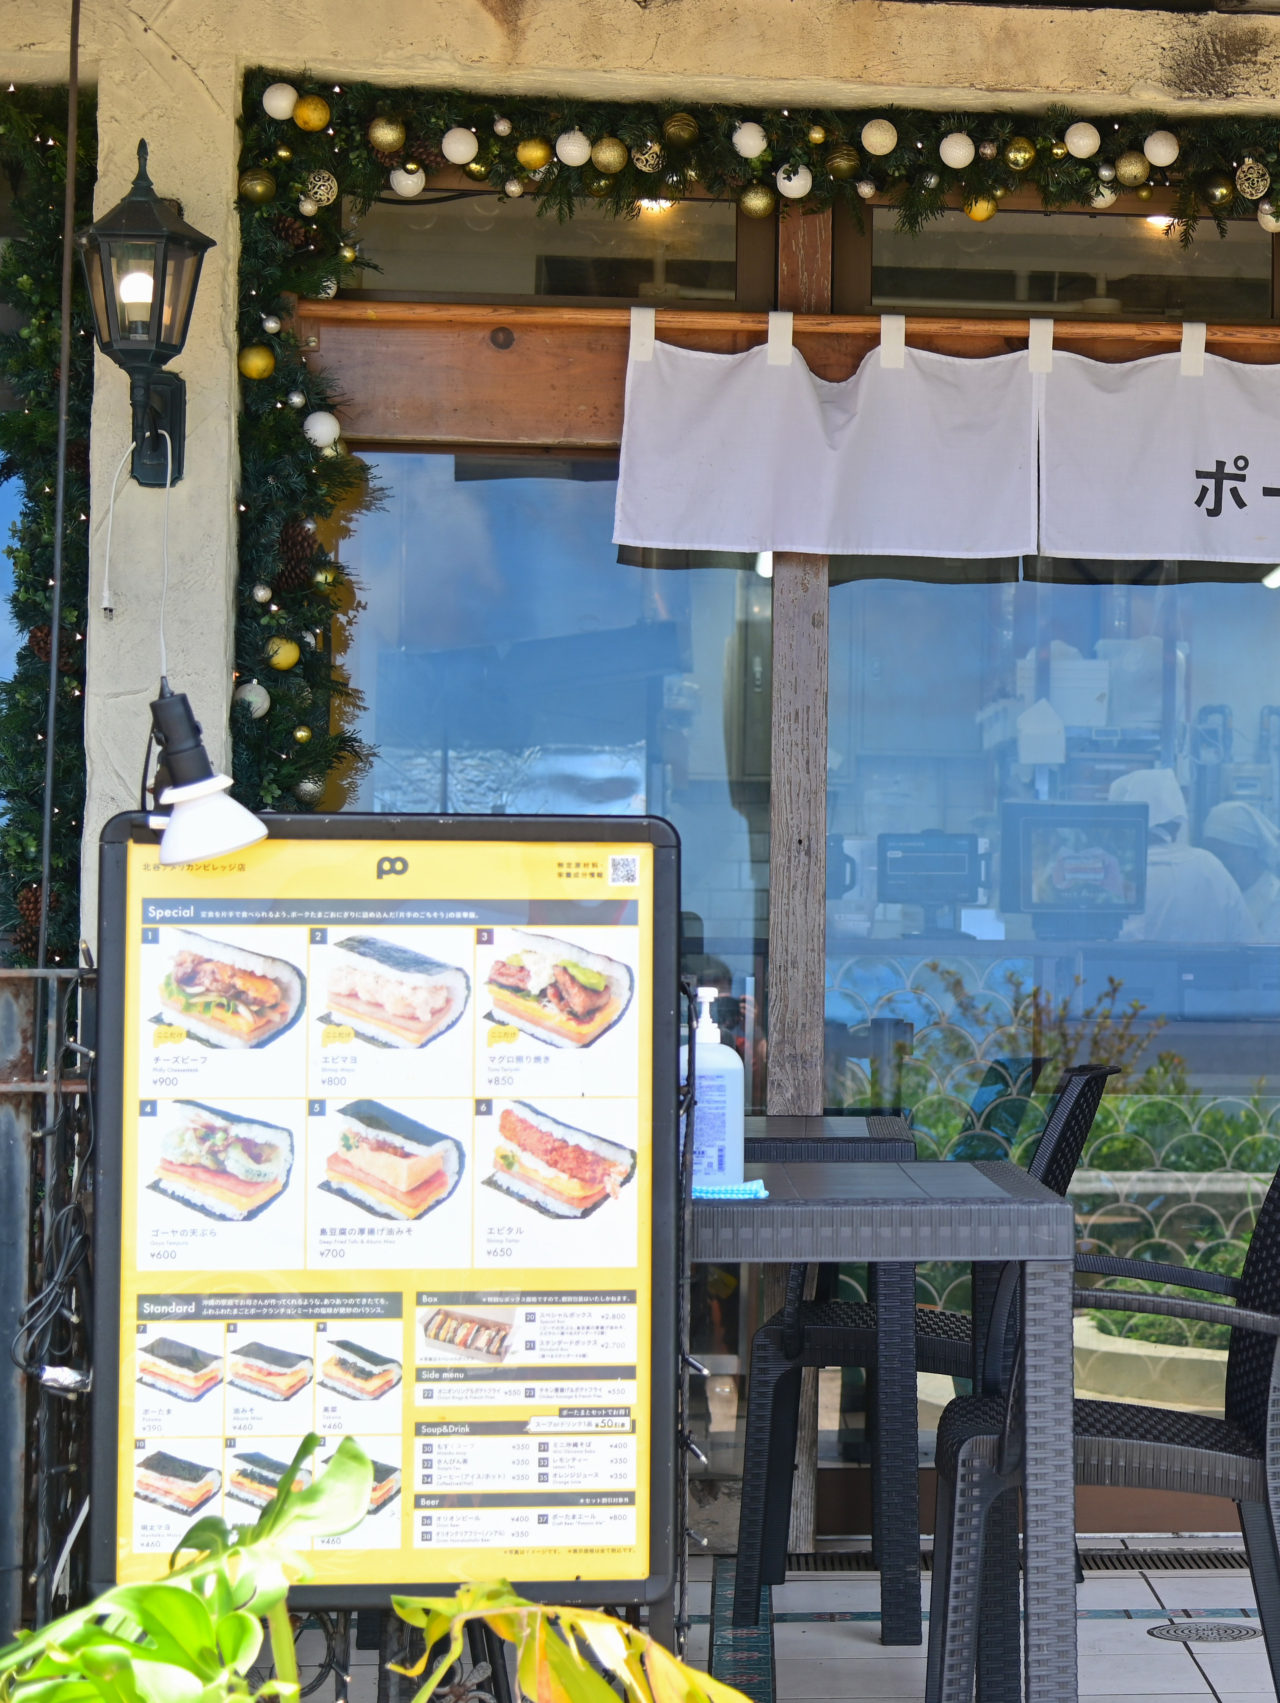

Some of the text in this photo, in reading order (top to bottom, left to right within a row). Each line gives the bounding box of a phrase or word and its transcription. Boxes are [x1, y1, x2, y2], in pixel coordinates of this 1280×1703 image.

[148, 905, 194, 920] Special
[315, 932, 321, 940] 2
[482, 932, 488, 941] 3
[153, 1056, 208, 1064] チーズビーフ
[321, 1056, 357, 1064] エビマヨ
[488, 1055, 550, 1064] マグロ照り焼き
[152, 1077, 178, 1086] ¥900
[321, 1077, 346, 1086] ¥800
[487, 1076, 514, 1086] ¥850
[145, 1104, 151, 1112] 4
[314, 1104, 320, 1112] 5
[480, 1103, 486, 1112] 6
[151, 1228, 217, 1237] ゴーヤの天ぷら
[487, 1227, 524, 1235] エビタル
[150, 1251, 176, 1260] ¥600
[320, 1249, 345, 1258] ¥700
[486, 1248, 512, 1257] ¥650
[422, 1295, 438, 1303] Box
[143, 1303, 195, 1314] Standard
[422, 1370, 440, 1379] Side
[322, 1422, 343, 1430] ¥460
[421, 1424, 470, 1434] Soup&Drink
[420, 1498, 440, 1506] Beer
